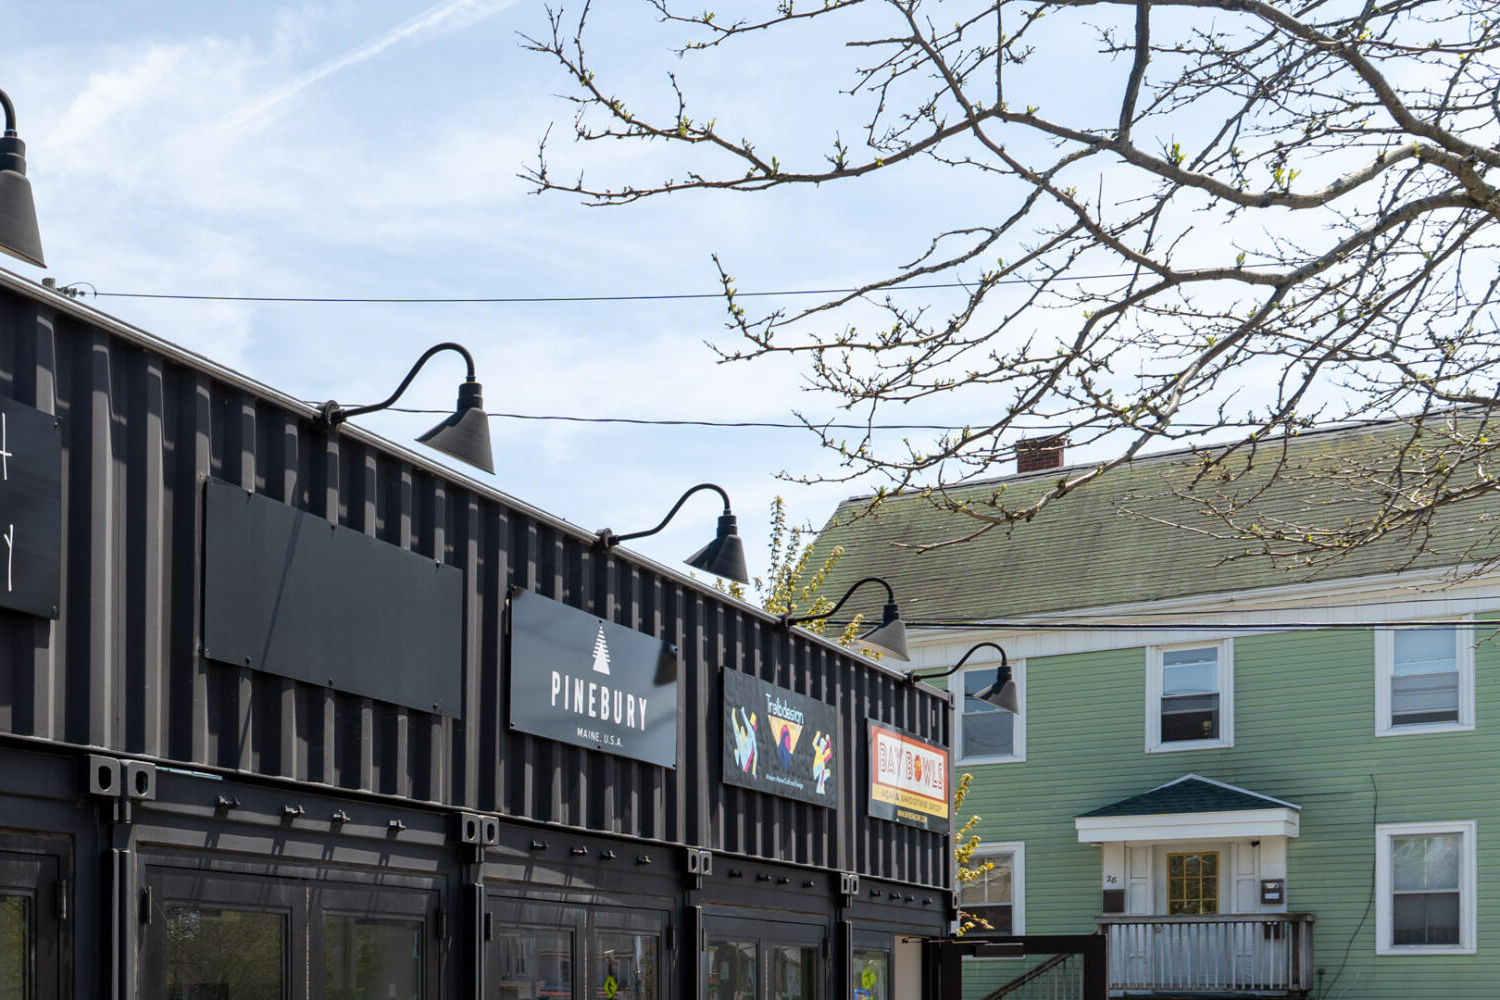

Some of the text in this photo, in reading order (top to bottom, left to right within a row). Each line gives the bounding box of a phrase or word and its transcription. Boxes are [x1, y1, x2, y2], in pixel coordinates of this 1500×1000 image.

[551, 670, 648, 732] PINEBURY
[603, 734, 624, 748] U.S.A.
[879, 742, 944, 791] BAY BOWLS
